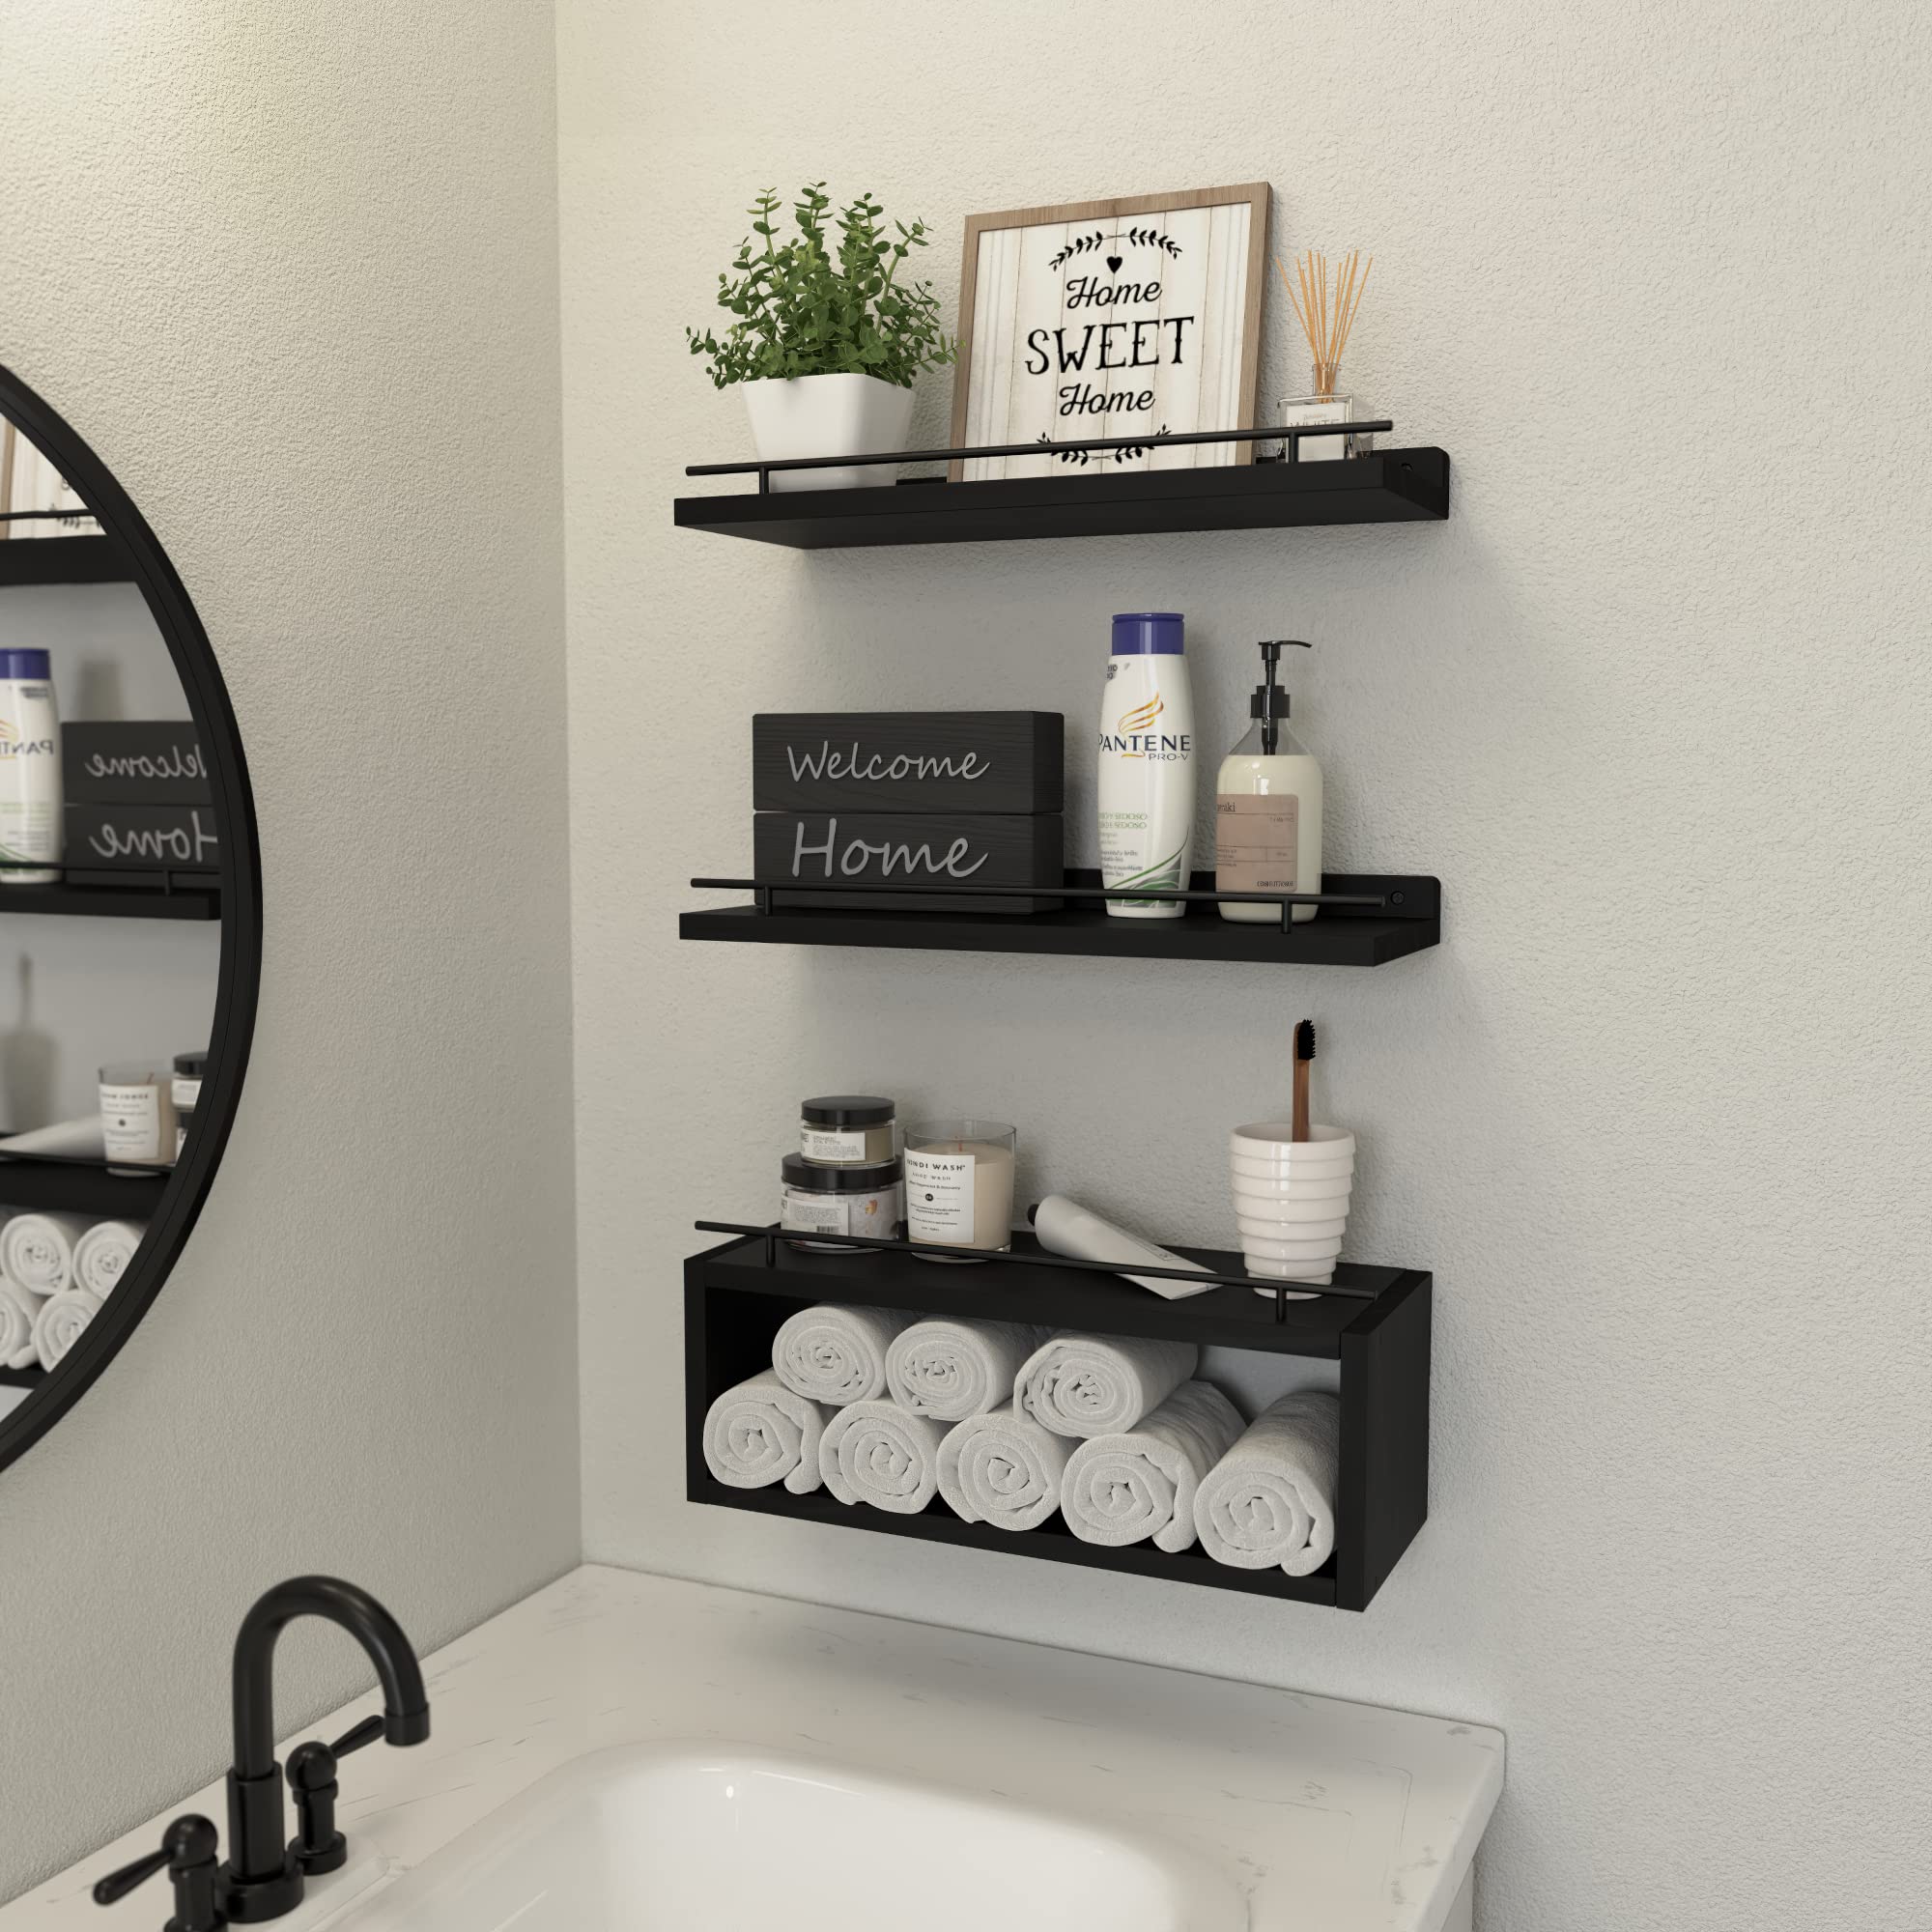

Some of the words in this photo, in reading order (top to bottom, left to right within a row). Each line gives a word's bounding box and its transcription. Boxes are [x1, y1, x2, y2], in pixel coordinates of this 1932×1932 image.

[1065, 275, 1162, 309] Home
[1024, 315, 1195, 376] SWEET
[1059, 383, 1155, 416] Home
[787, 740, 990, 781] Welcome
[1148, 753, 1188, 761] PRO-V
[791, 817, 989, 877] Home
